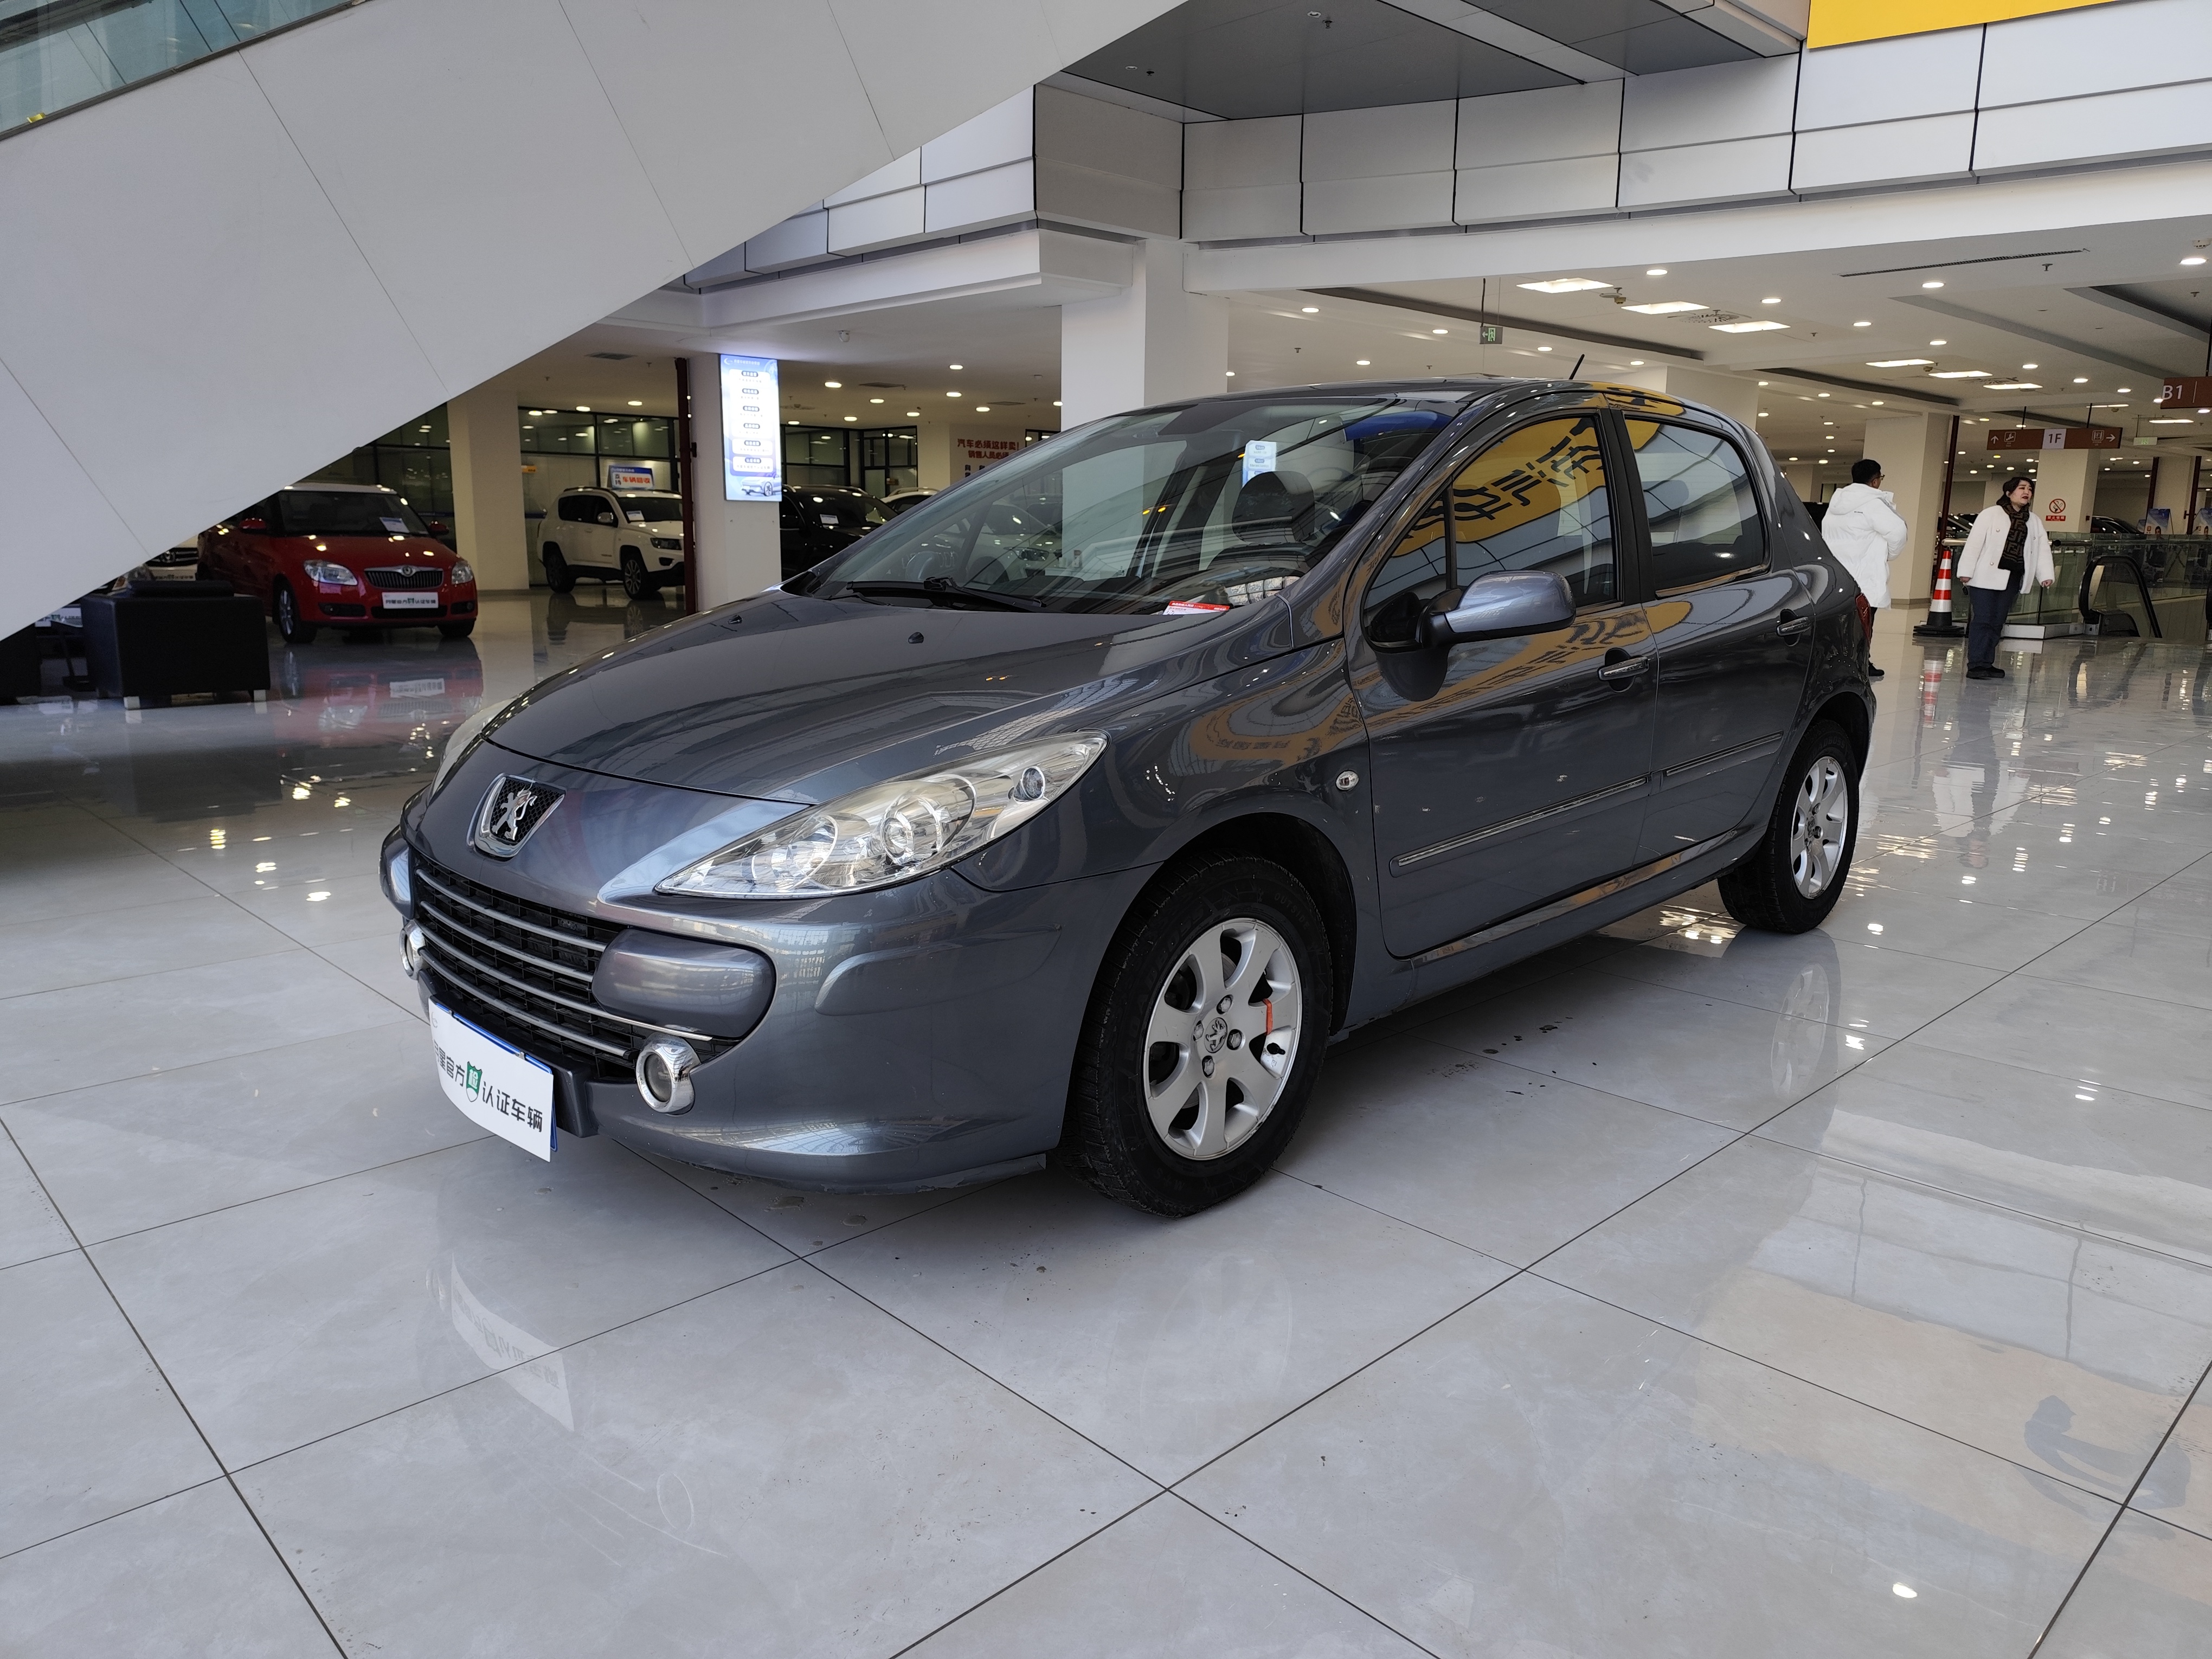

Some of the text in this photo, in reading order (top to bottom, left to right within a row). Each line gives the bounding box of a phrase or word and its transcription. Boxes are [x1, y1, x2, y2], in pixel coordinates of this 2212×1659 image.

[2162, 384, 2183, 400] B1
[2048, 433, 2062, 443] 1F
[482, 1081, 543, 1133] 认证车辆
